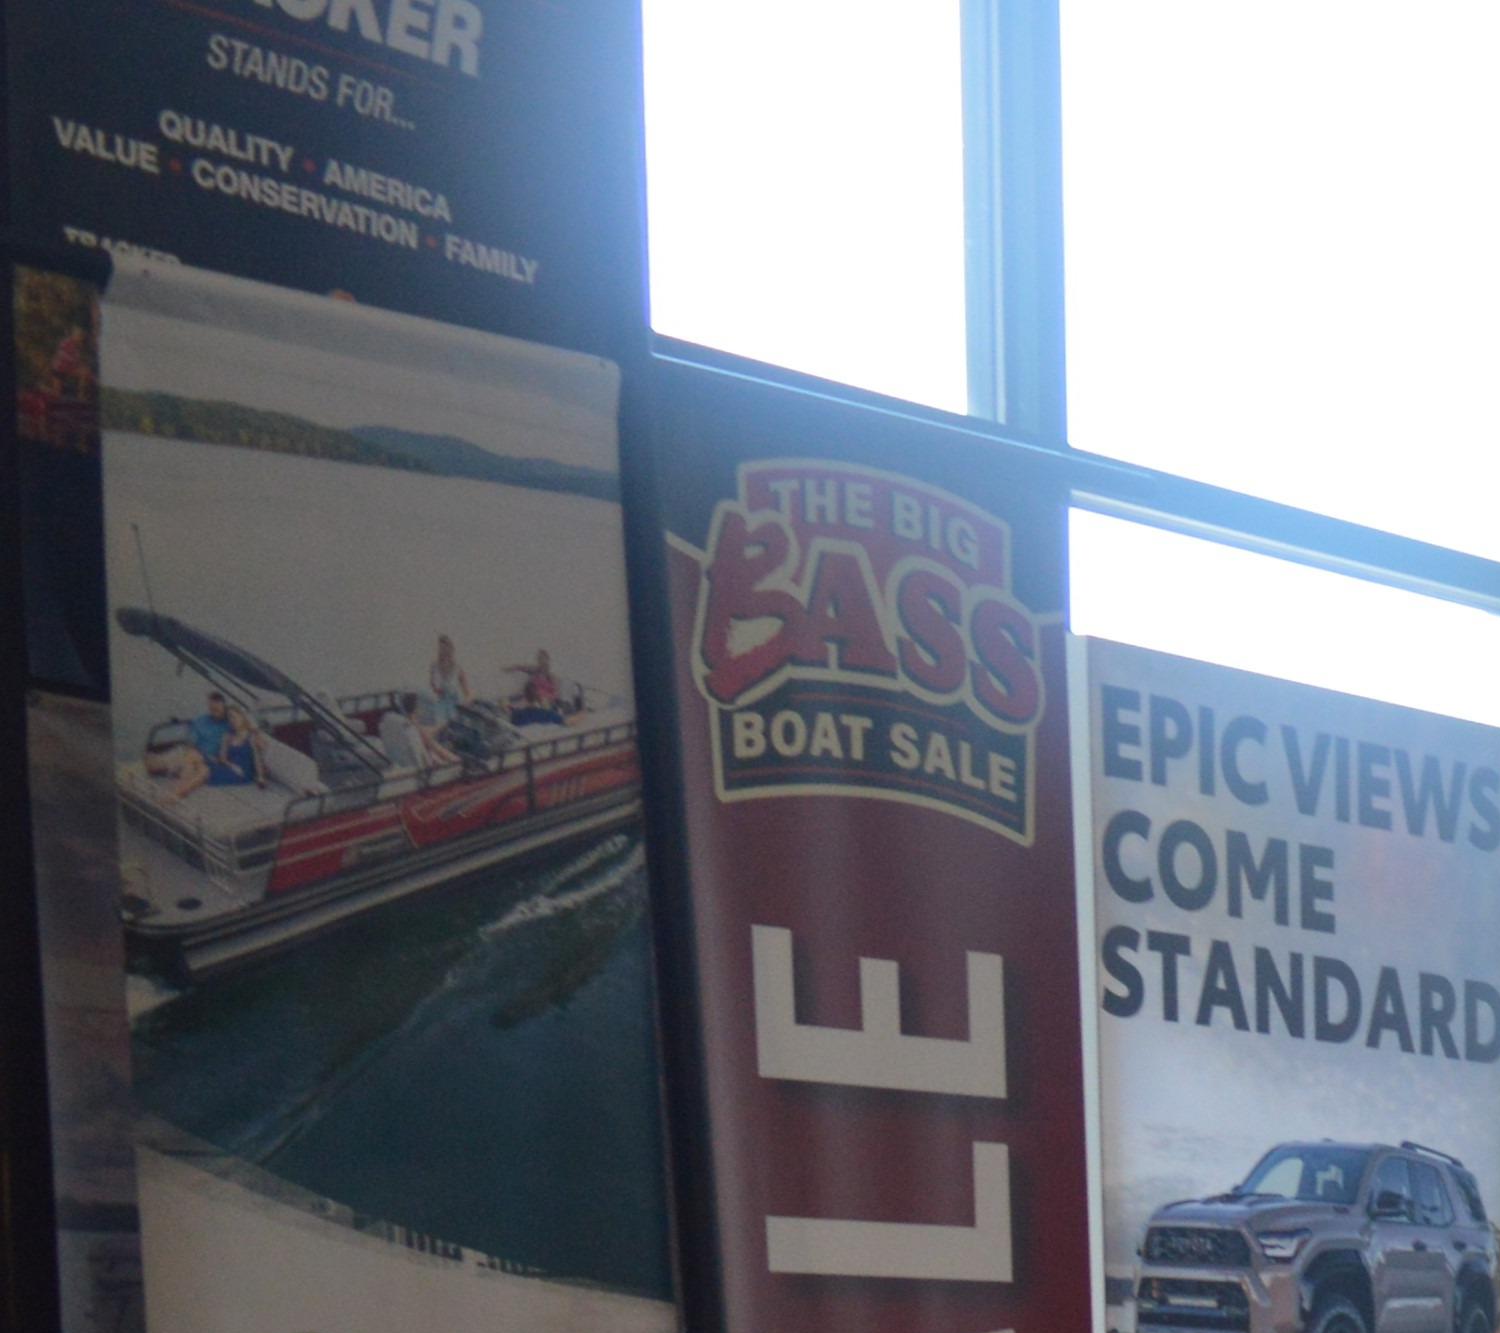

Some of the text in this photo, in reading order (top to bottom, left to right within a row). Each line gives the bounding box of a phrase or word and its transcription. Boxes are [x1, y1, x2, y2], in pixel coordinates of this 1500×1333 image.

[206, 33, 415, 130] STANDS FOR...
[52, 115, 539, 285] VALUE CONSERVATION FAMILY
[158, 109, 452, 223] QUALITY AMERICA
[770, 480, 978, 570] THE BIG
[700, 512, 1042, 727] BASS
[733, 710, 1017, 802] BOAT SALE
[1101, 684, 1269, 807] EPIC
[1103, 809, 1337, 935] COME
